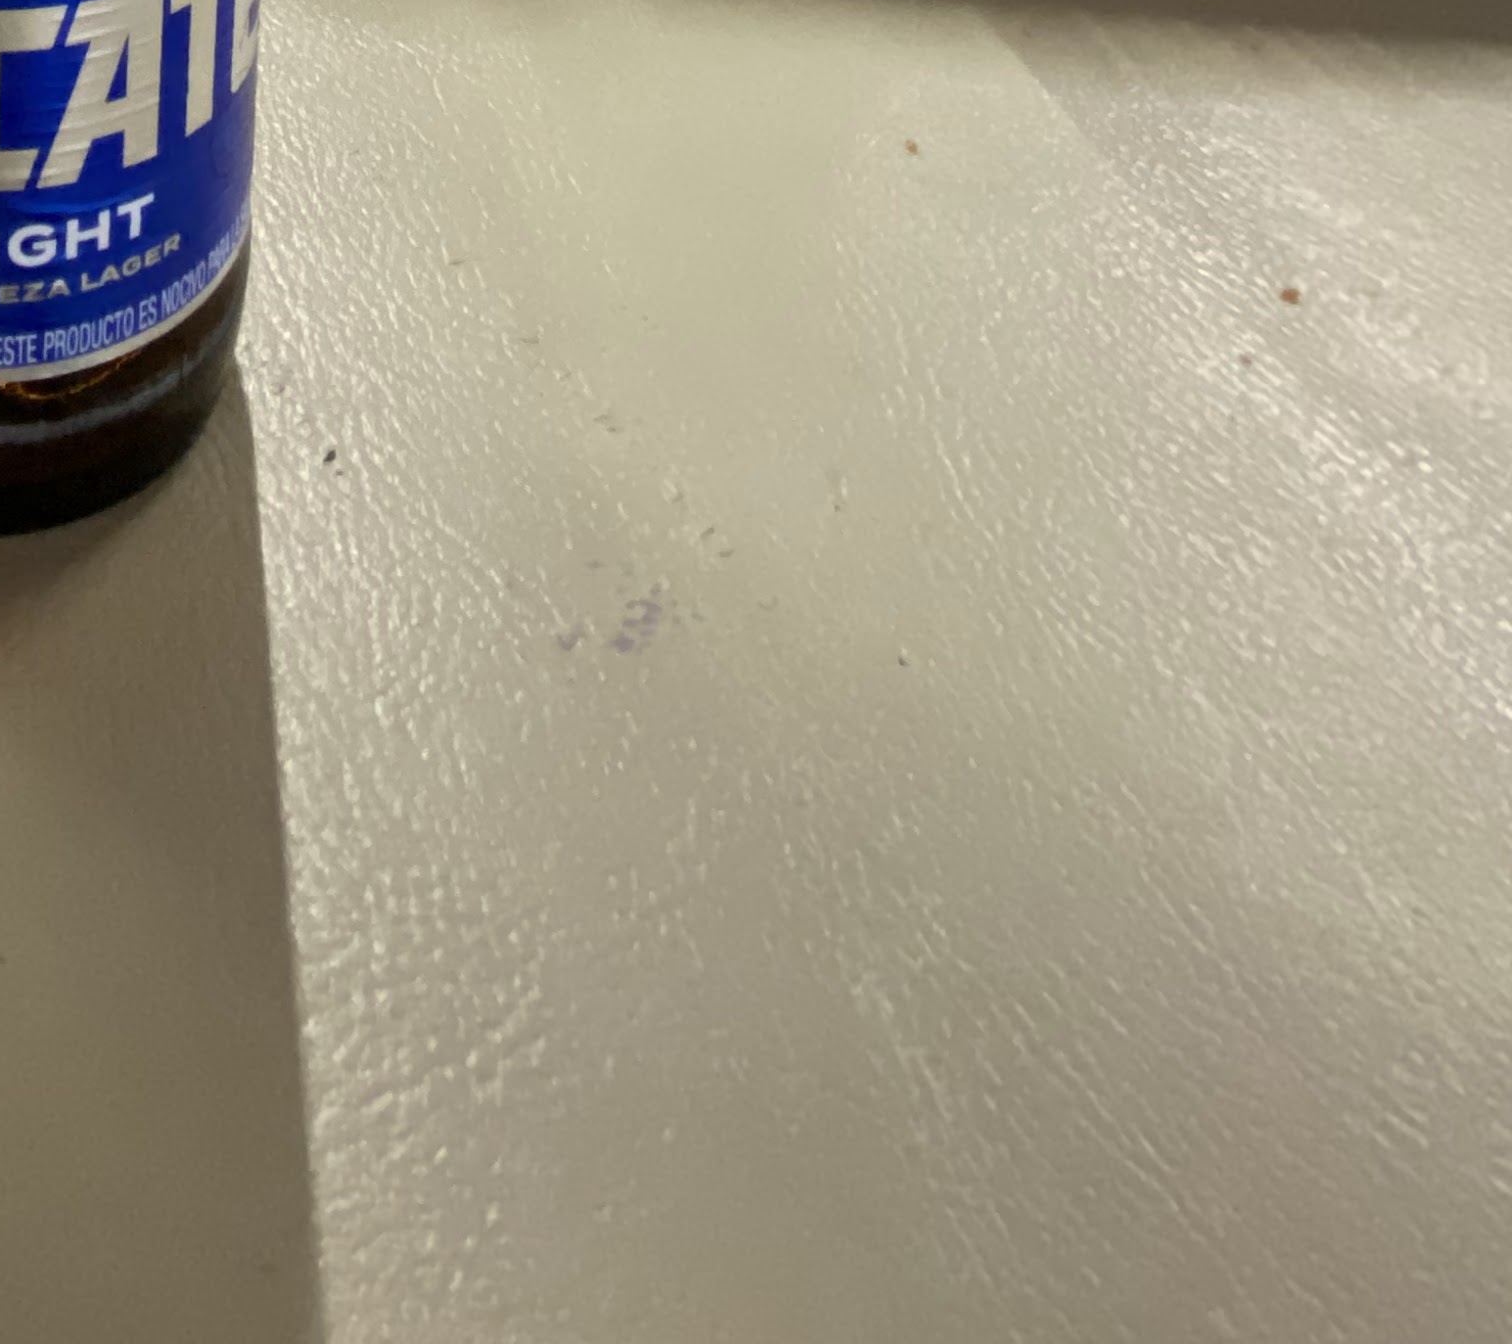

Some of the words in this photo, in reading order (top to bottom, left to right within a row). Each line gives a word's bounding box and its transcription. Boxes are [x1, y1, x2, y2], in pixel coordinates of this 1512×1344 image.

[81, 233, 181, 292] LAGER
[43, 306, 135, 361] PRODUCTO
[139, 295, 158, 330] ES
[161, 261, 207, 317] NOCIVO
